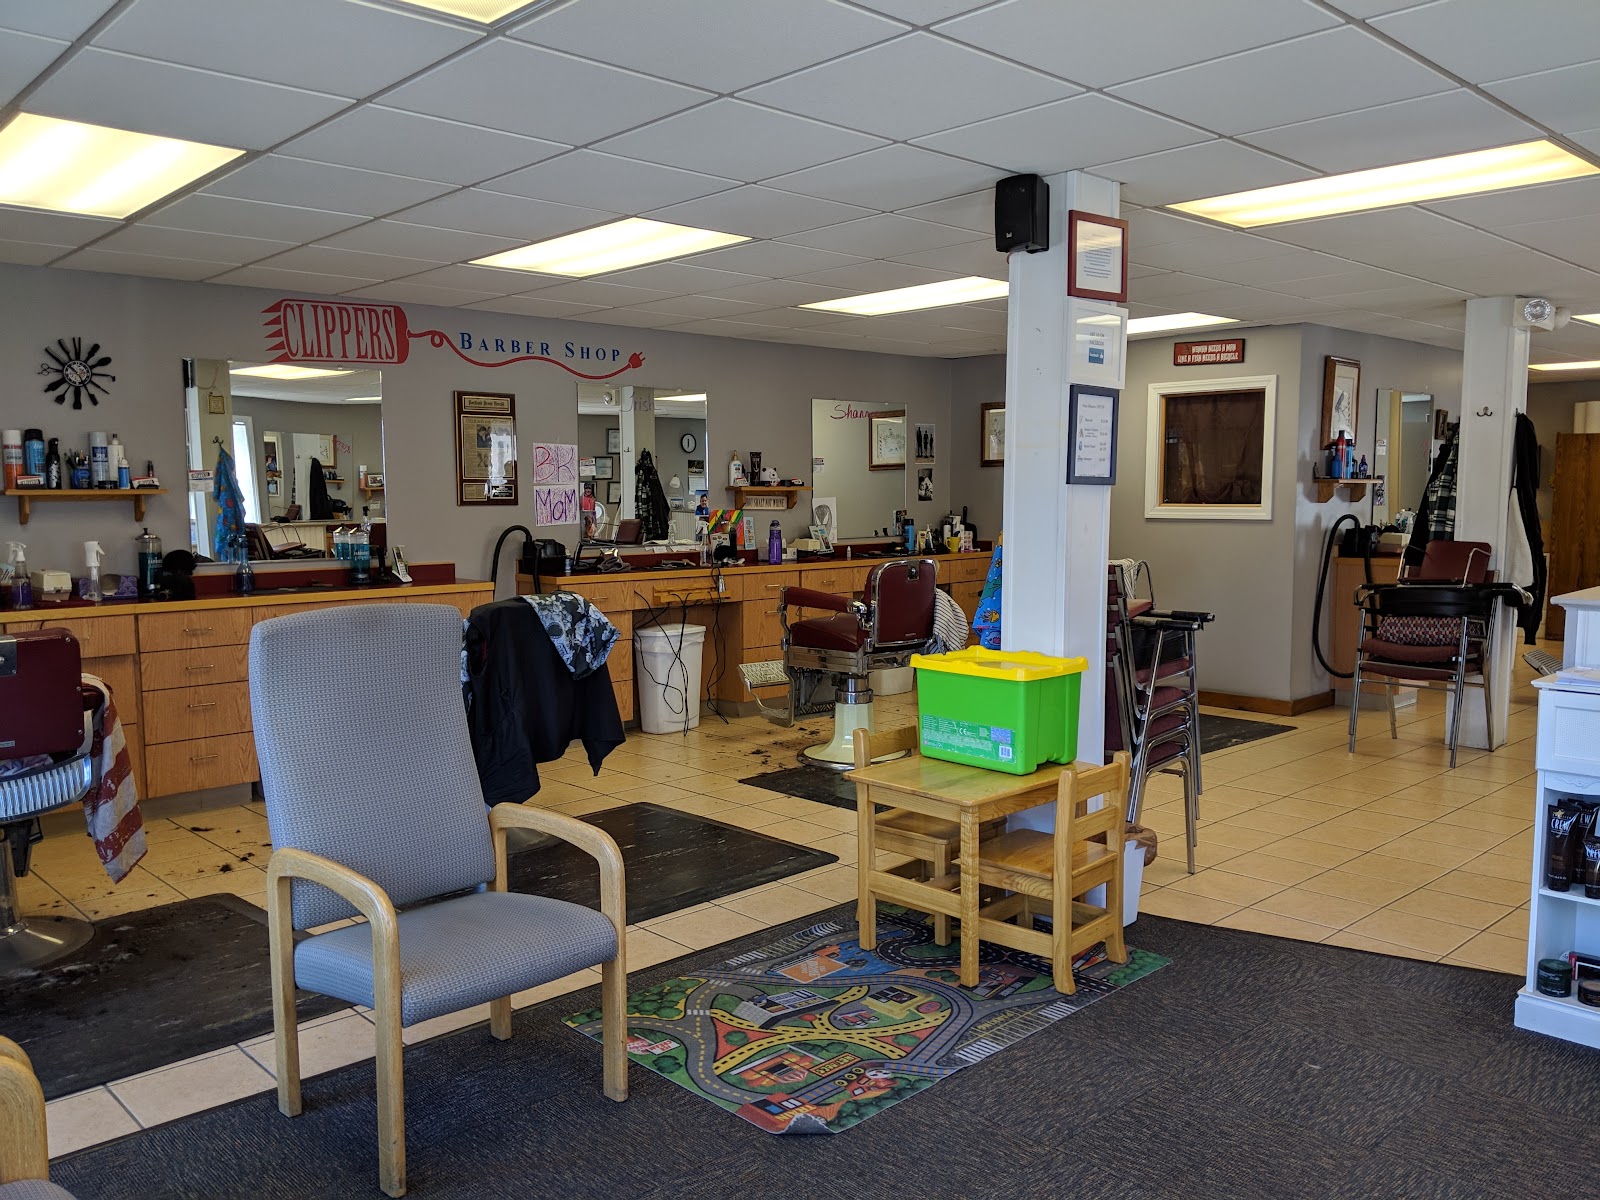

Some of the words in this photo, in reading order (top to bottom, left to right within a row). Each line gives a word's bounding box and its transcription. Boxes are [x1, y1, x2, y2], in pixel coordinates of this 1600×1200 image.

[282, 302, 396, 360] CLIPPERS
[535, 446, 576, 483] BK
[1551, 818, 1570, 831] CREW
[1587, 848, 1600, 859] CRE
